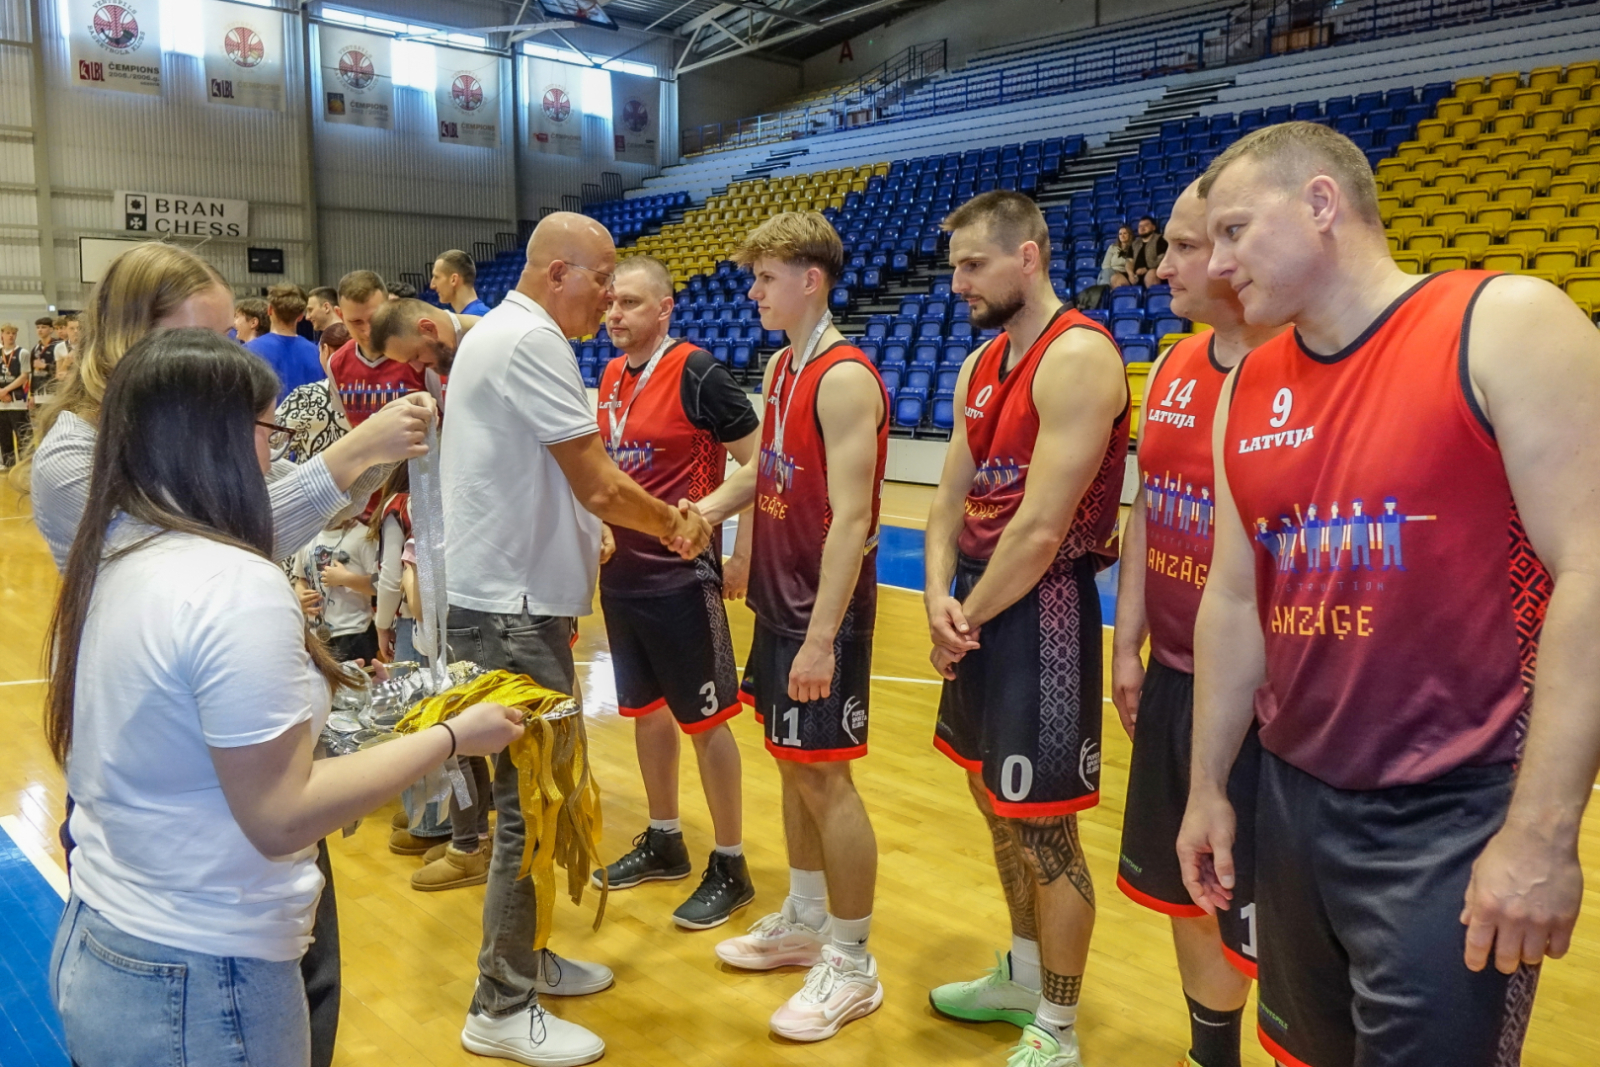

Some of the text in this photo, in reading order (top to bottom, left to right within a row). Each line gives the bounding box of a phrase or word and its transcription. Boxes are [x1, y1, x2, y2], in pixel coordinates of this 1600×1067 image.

[108, 62, 160, 75] ČEMPIONS
[156, 199, 224, 217] BRAN
[156, 218, 240, 237] CHESS
[975, 384, 993, 408] 0
[1160, 378, 1198, 410] 14
[1269, 387, 1294, 428] 9
[1148, 409, 1196, 429] LATVIJA
[1238, 426, 1315, 454] LATVIJA
[1147, 547, 1208, 590] ANZĀĢ
[699, 681, 718, 716] 3
[1001, 755, 1033, 801] 0
